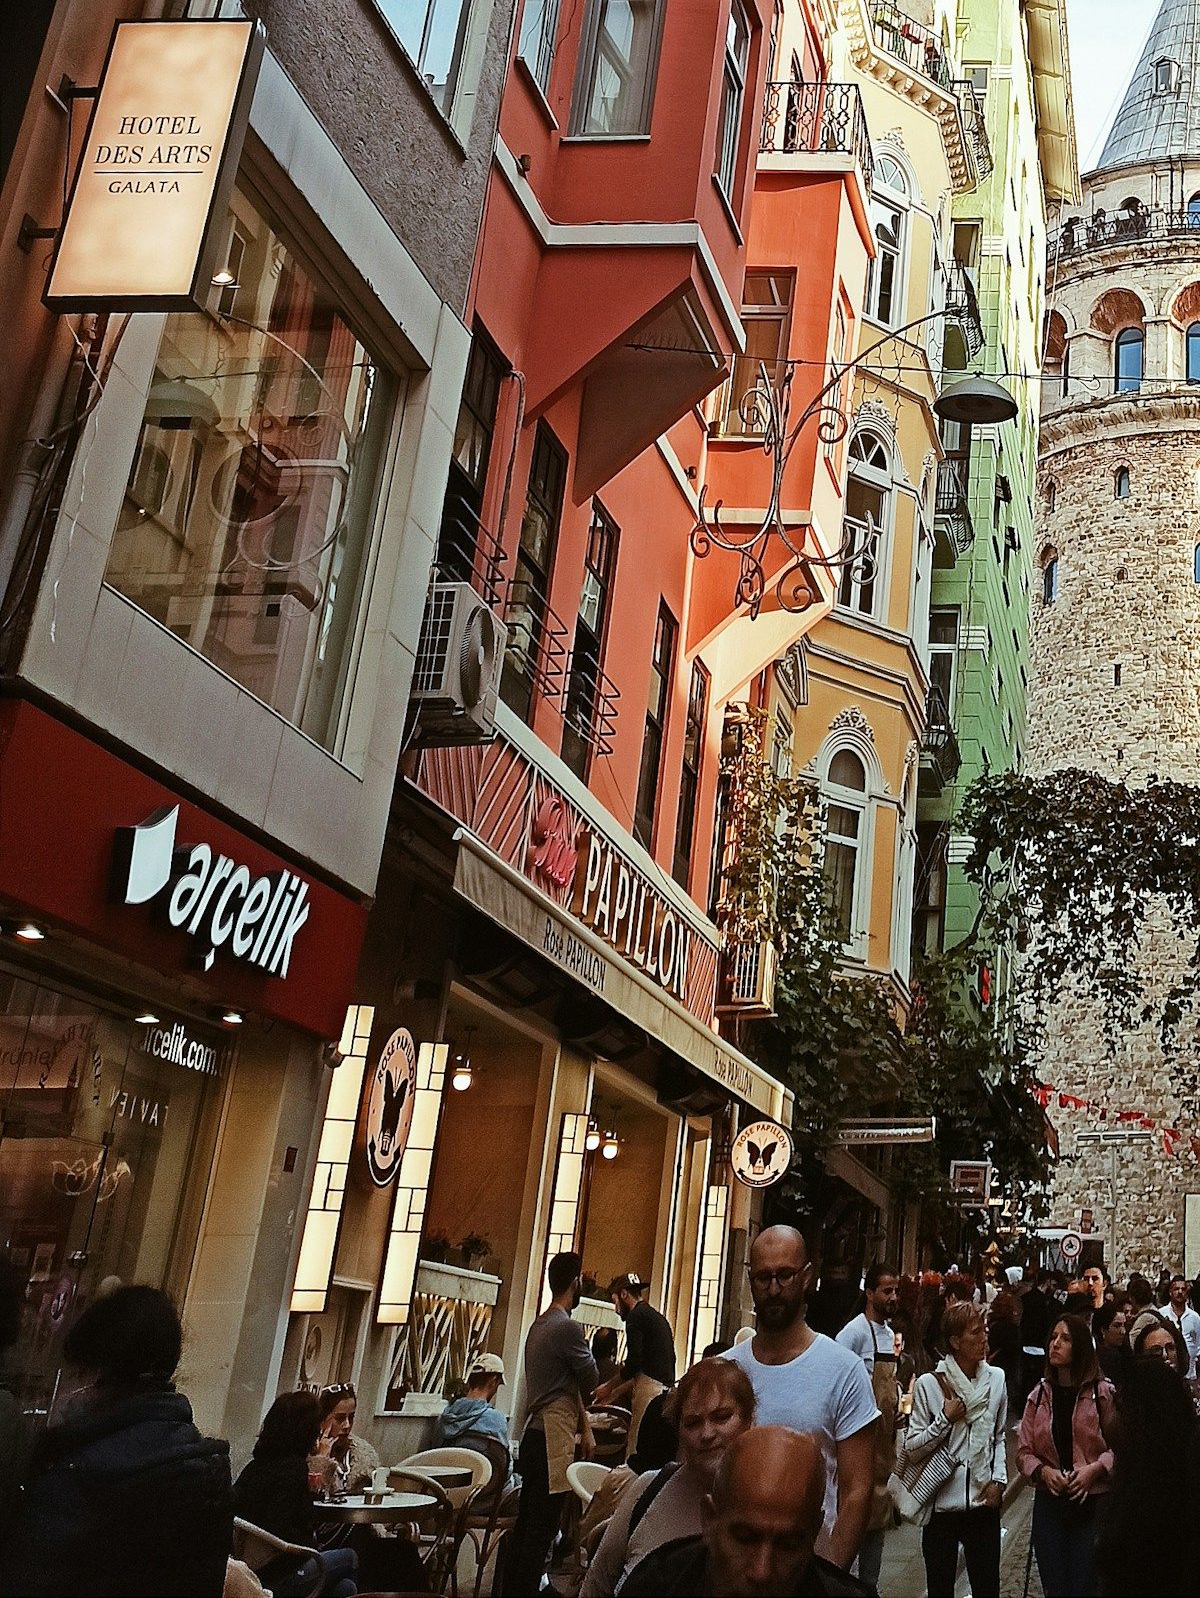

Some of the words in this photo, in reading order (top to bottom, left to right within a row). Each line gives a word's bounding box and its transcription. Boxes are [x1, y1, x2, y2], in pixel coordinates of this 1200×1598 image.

[118, 116, 201, 135] HOTEL
[93, 145, 144, 165] DES
[148, 145, 212, 165] ARTS
[108, 180, 180, 194] GALATA
[168, 842, 311, 980] arçelik
[581, 832, 691, 1001] PAPILLON
[565, 935, 607, 993] PAPILLON
[736, 1128, 755, 1148] ROSE
[756, 1123, 787, 1150] PAPILLON
